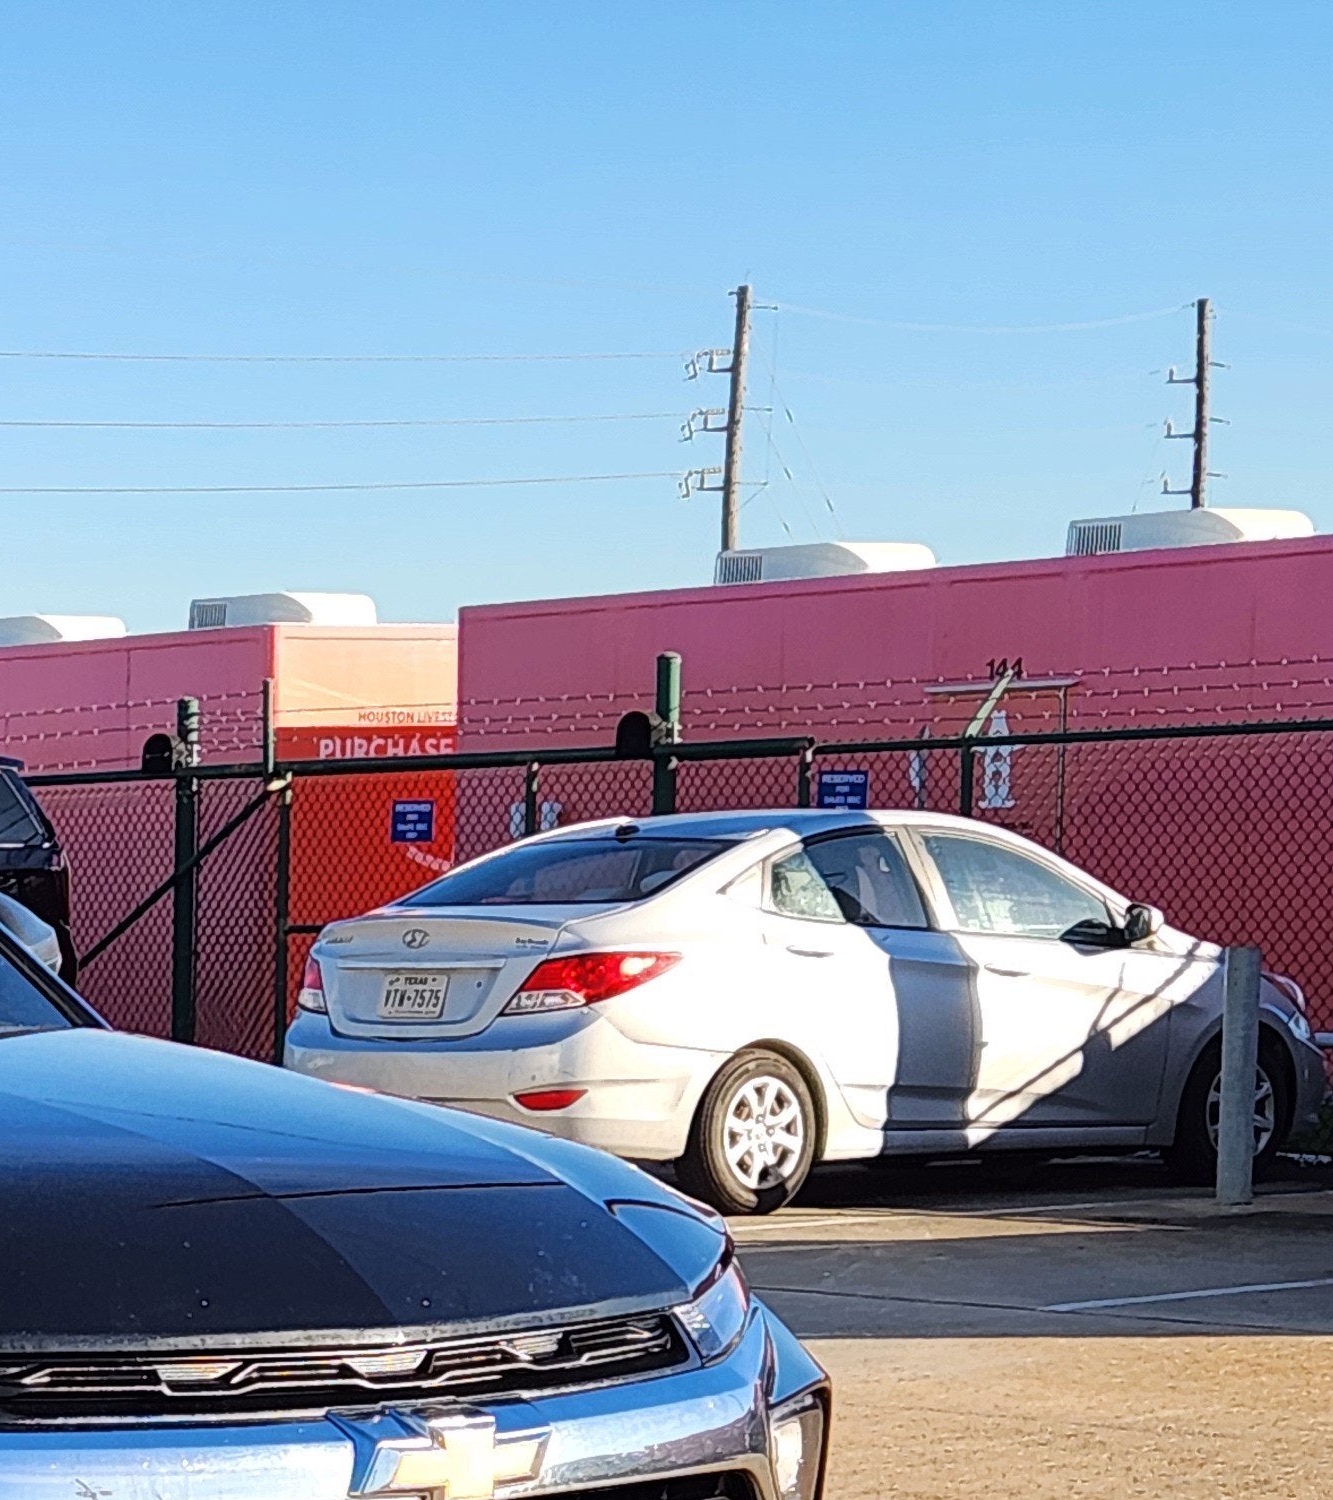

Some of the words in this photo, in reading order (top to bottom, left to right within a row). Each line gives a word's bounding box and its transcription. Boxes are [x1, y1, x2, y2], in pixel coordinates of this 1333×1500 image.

[986, 657, 1023, 681] 144
[358, 711, 414, 723] HOUSTON
[319, 737, 453, 760] PURCHASE
[404, 976, 429, 986] TEXAS
